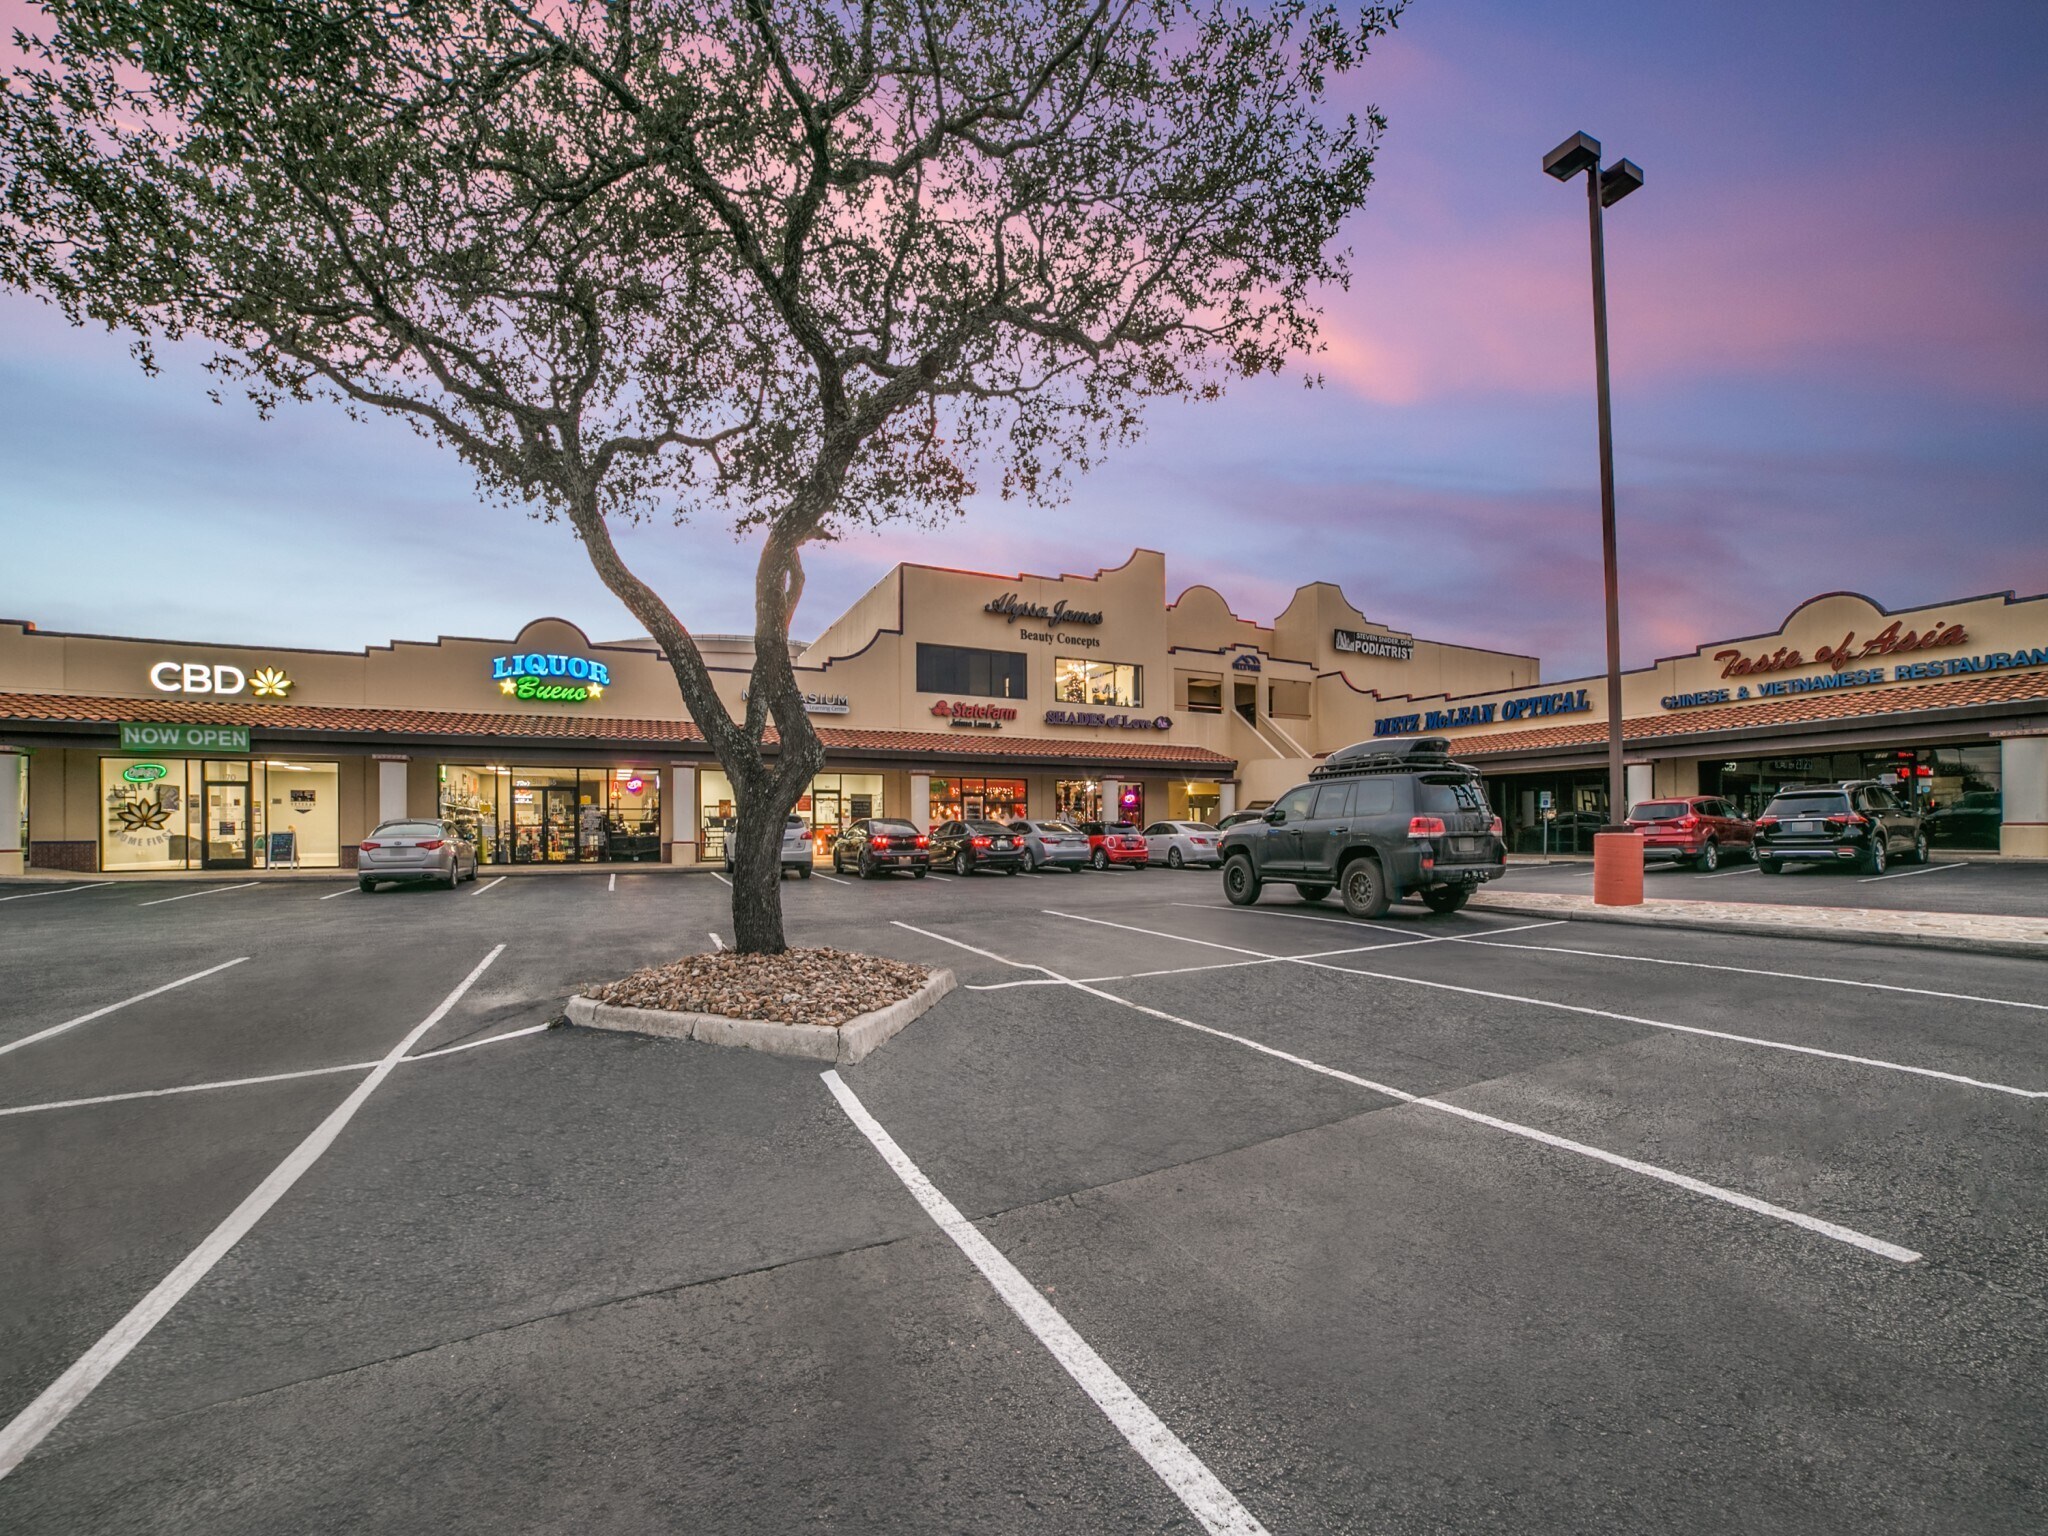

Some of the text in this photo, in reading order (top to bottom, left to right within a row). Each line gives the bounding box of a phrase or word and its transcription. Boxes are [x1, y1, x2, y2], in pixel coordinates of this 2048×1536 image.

[985, 592, 1103, 627] Alyssa James
[1020, 628, 1100, 649] Beauty Concepts
[1356, 633, 1378, 642] STEVEN
[1355, 641, 1413, 660] PODIATRIST
[1713, 620, 1969, 679] Taste of Asia
[150, 661, 245, 694] CBD
[492, 653, 610, 685] LIQUOR
[516, 676, 589, 702] Bueno
[1660, 688, 1730, 709] CHINESE
[1737, 686, 1750, 699] &
[1756, 667, 1884, 697] VIETNAMESE
[1045, 710, 1152, 729] SHADES of Love
[1373, 689, 1590, 736] DIETZ McLEAN OPTICAL
[124, 727, 247, 747] NOW OPEN
[128, 767, 161, 779] OPEN
[146, 829, 175, 846] FIRST
